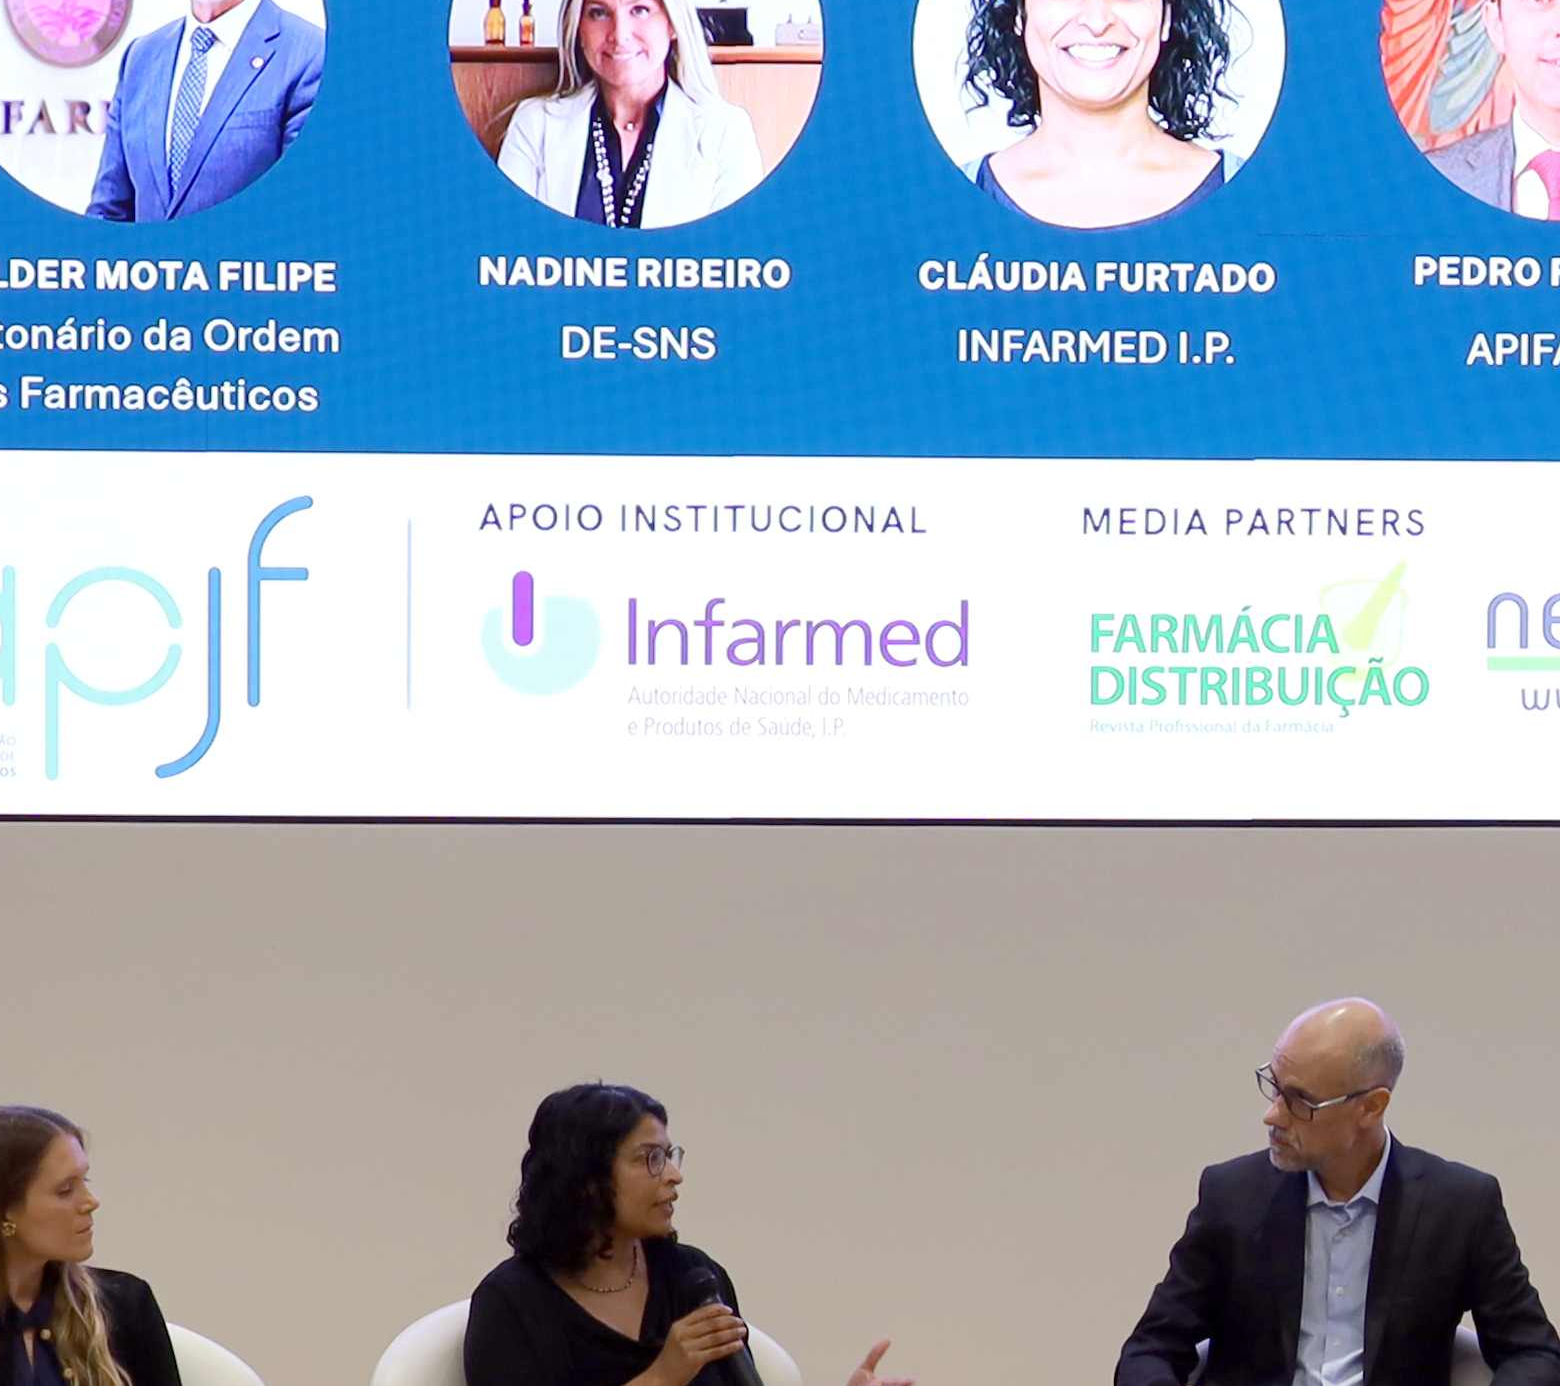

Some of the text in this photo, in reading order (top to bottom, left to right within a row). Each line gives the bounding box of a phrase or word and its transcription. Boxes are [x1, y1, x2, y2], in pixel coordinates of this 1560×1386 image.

[95, 260, 209, 291] MOTA
[218, 260, 336, 292] FILIPE
[478, 257, 792, 289] NADINE RIBEIRO
[919, 252, 1277, 293] CLÁUDIA FURTADO
[1415, 255, 1542, 287] PEDRO
[143, 319, 191, 351] da
[204, 319, 340, 352] Ordem
[561, 325, 717, 360] DE-SNS
[959, 329, 1235, 364] INFARMED I.P.
[20, 376, 318, 411] Farmacêuticos
[480, 504, 926, 533] APOIO INSTITUCIONAL
[1084, 508, 1424, 536] MEDIA PARTNERS
[628, 598, 968, 667] Infarmed
[1091, 606, 1340, 654] FARMÁCIA
[628, 685, 969, 707] Autoridade Nacional do Medicamento
[1091, 657, 1429, 718] DISTRIBUIÇÃO
[628, 721, 638, 735] e
[644, 717, 723, 736] Produtos
[730, 717, 751, 735] de
